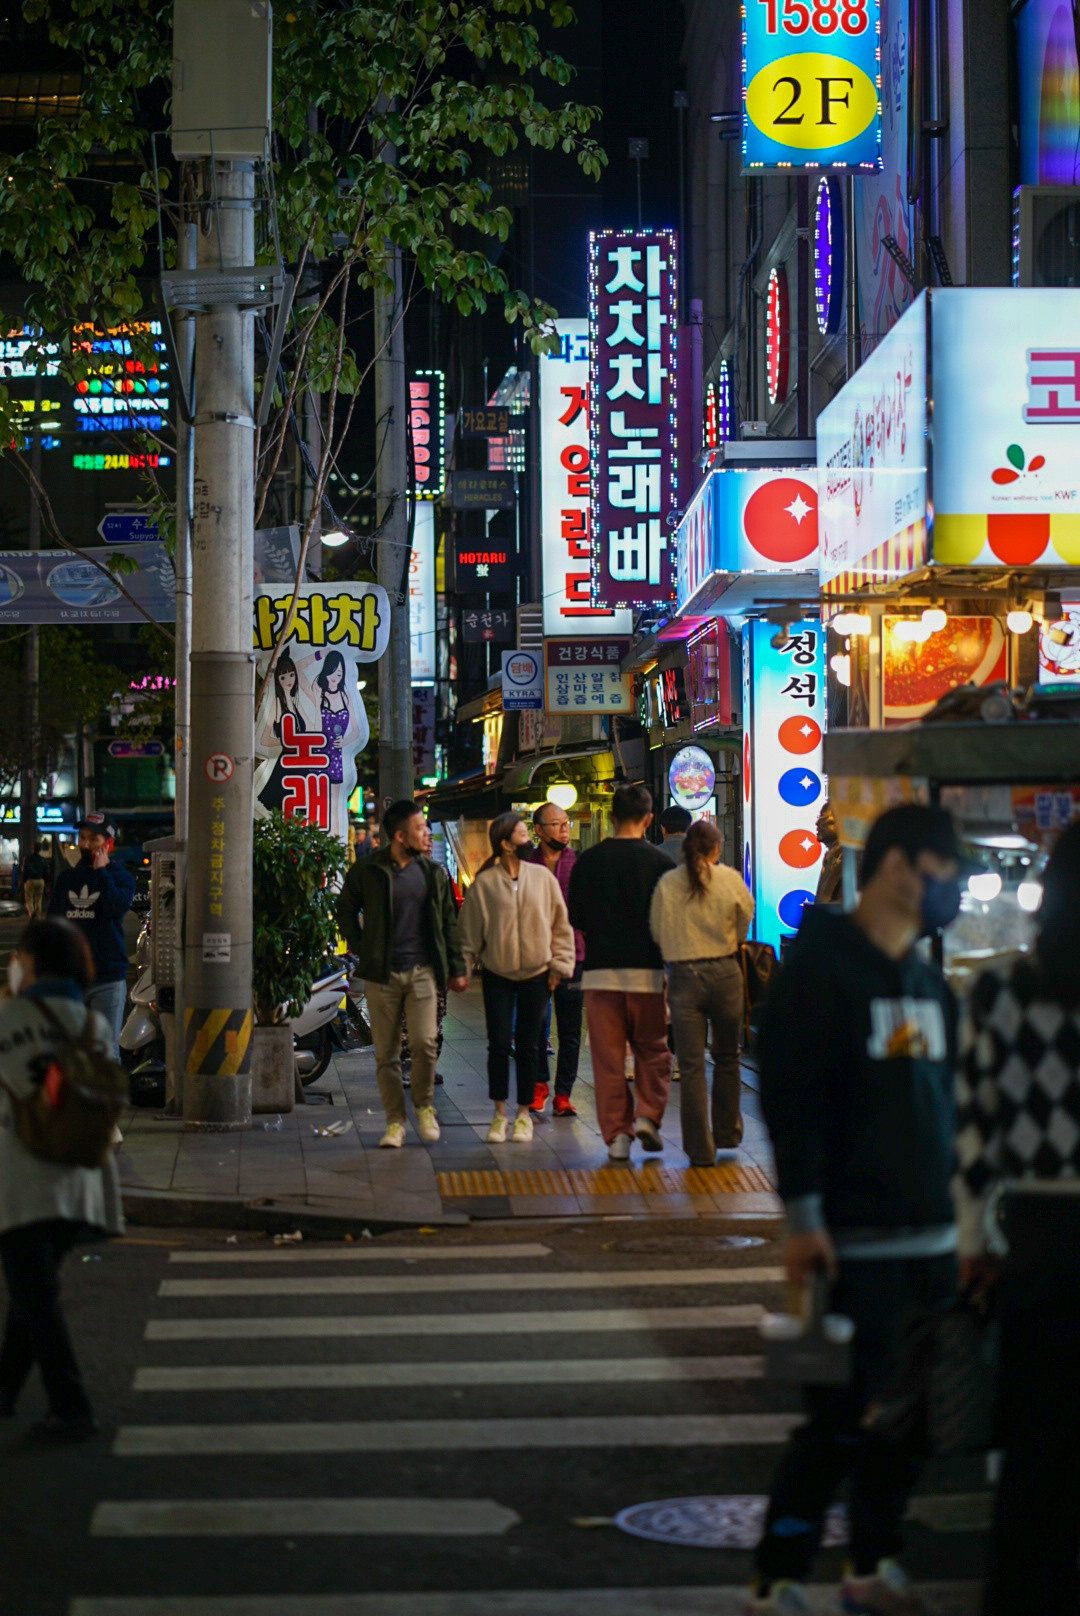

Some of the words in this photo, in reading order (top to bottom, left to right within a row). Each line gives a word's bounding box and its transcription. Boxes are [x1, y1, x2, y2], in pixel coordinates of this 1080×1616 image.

[759, 0, 868, 35] 1588
[464, 411, 509, 433] 가요교실
[1054, 490, 1077, 500] KWF
[459, 552, 506, 564] HOTARU
[558, 646, 621, 661] 건강식품
[510, 662, 534, 674] 담배
[781, 630, 818, 707] 정석
[66, 909, 95, 919] adidas
